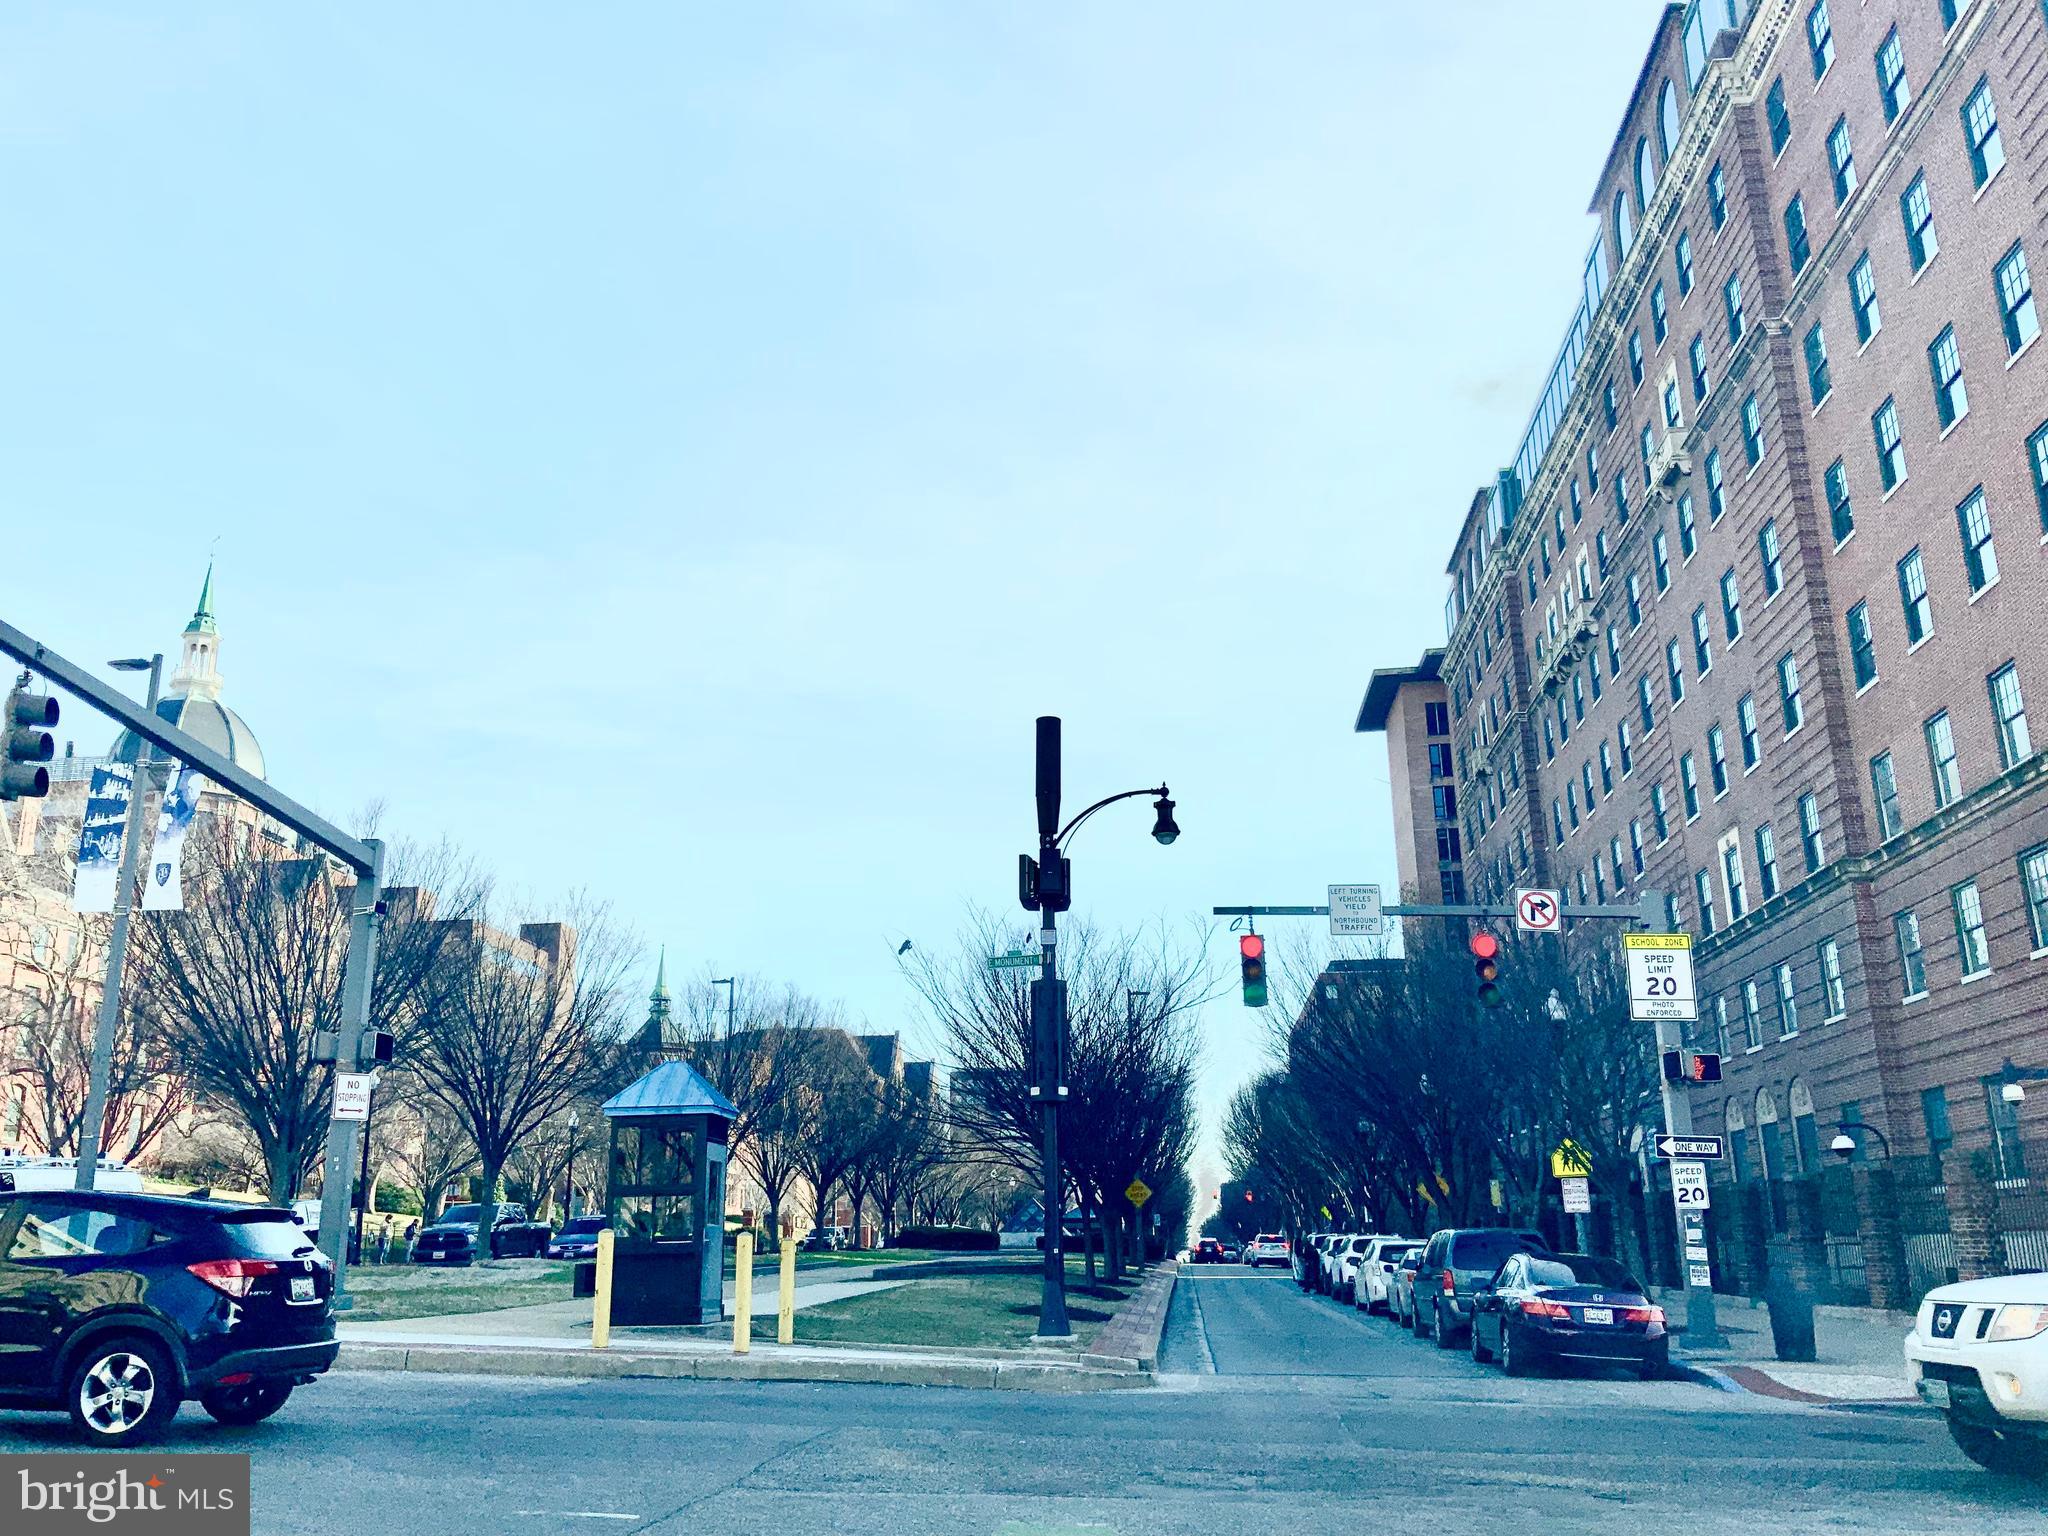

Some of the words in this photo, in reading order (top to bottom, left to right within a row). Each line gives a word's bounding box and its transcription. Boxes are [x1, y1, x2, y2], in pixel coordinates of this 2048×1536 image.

[1631, 938, 1660, 946] SCHOOL
[1664, 938, 1684, 946] ZONE
[994, 956, 1033, 967] MONUMENT
[1644, 955, 1674, 963] SPEED
[1646, 977, 1677, 996] 20
[347, 1081, 360, 1089] NO
[338, 1093, 367, 1102] STOPPING
[1675, 1142, 1693, 1152] ONE
[1695, 1143, 1714, 1152] WAY
[1678, 1187, 1705, 1203] 20
